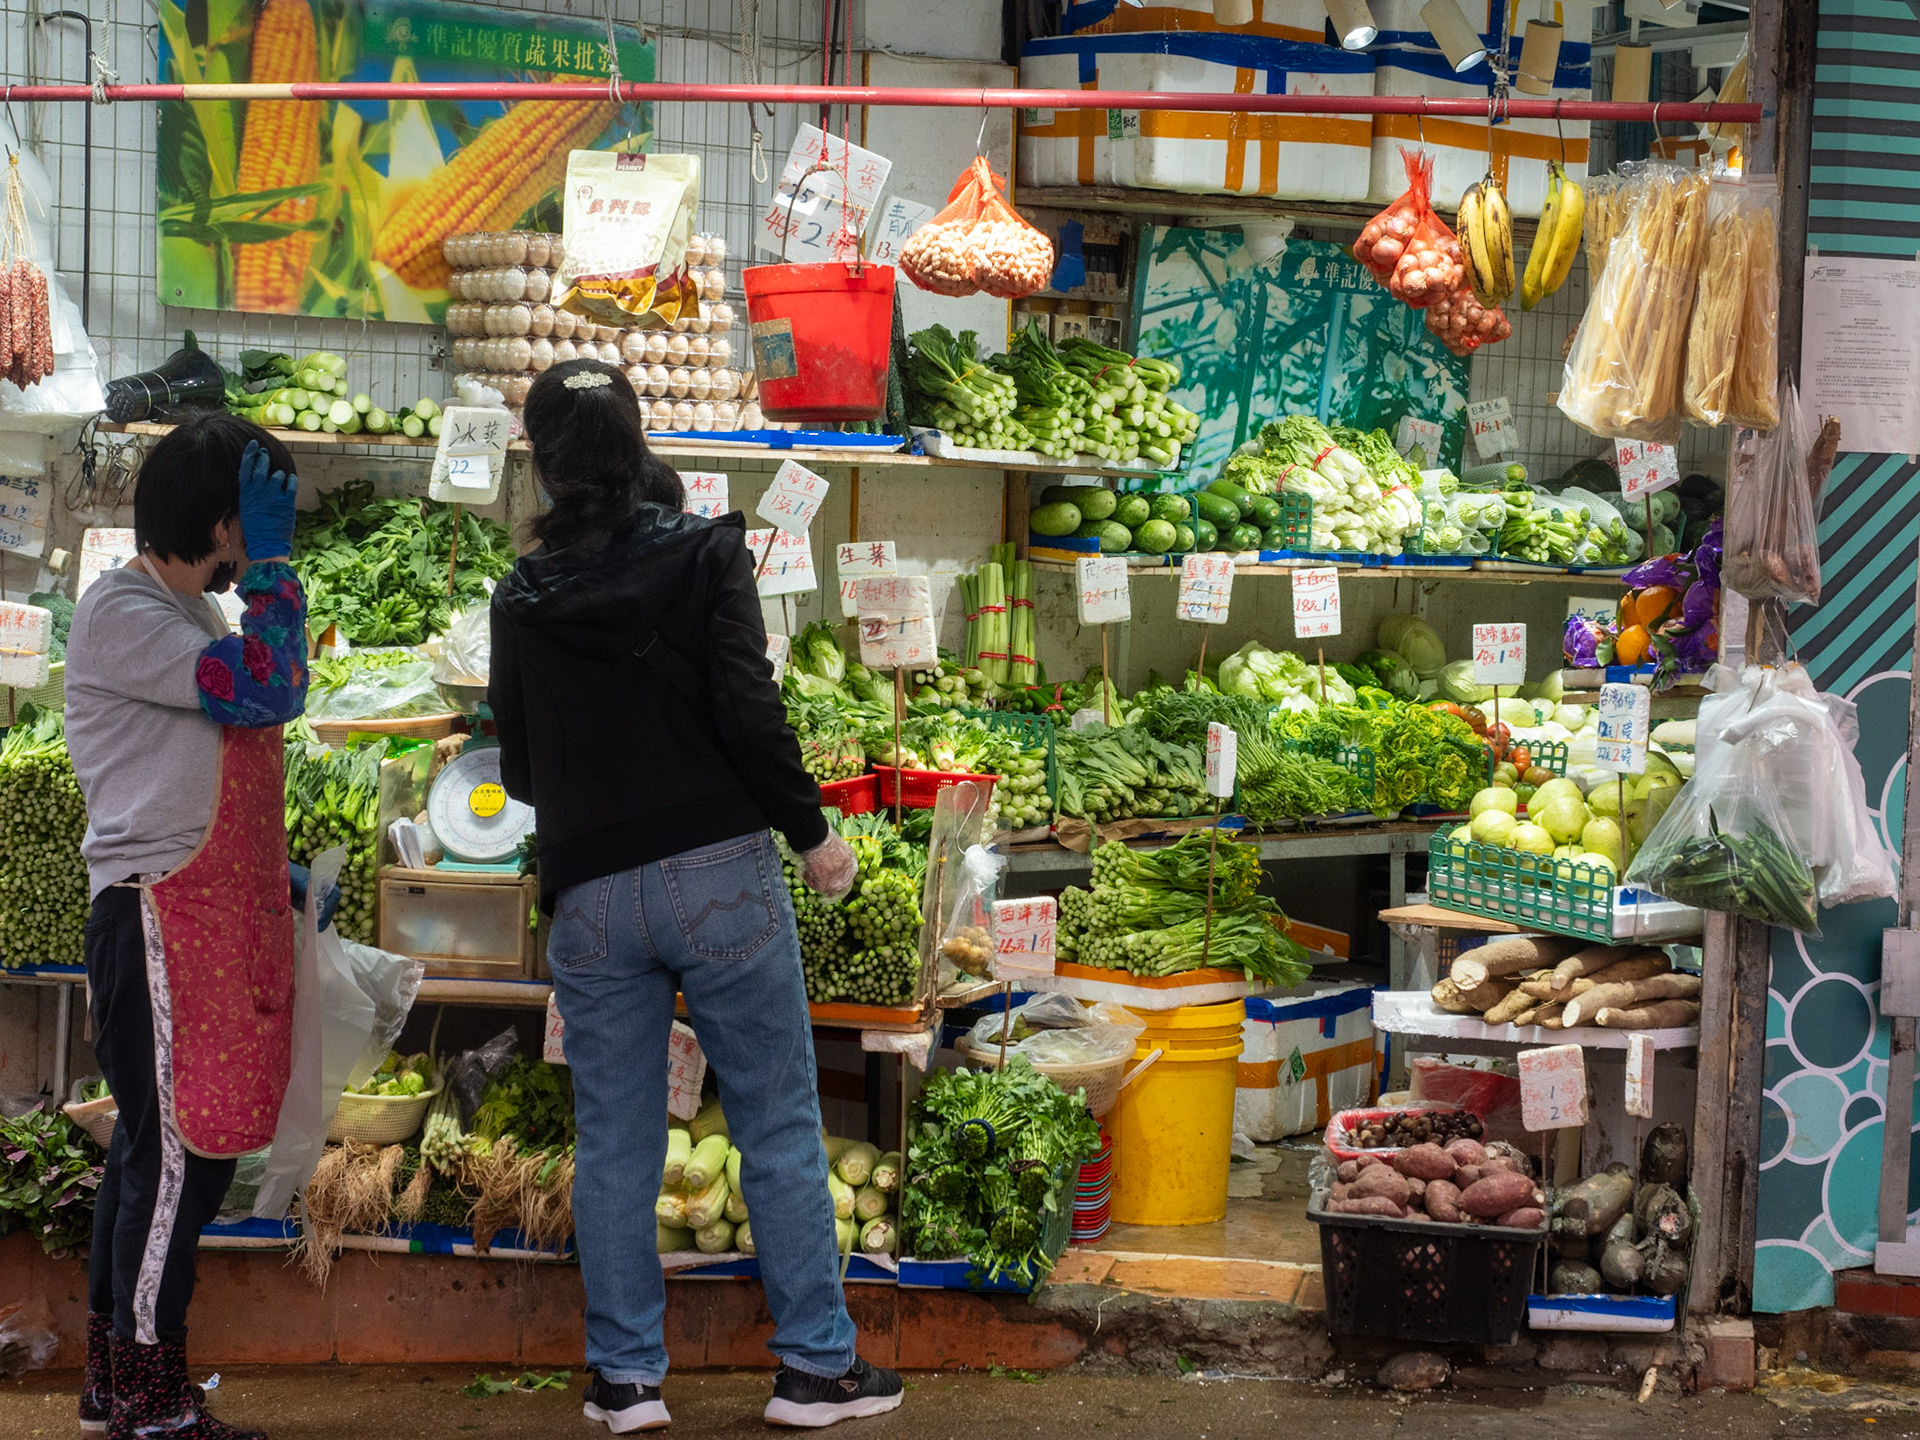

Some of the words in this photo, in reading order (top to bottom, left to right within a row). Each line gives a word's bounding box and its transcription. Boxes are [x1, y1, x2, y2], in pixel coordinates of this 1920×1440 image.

[1323, 262, 1389, 293] 準記優
[448, 420, 501, 450] 冰菜
[450, 459, 475, 474] 22
[840, 543, 891, 568] 生菜
[1184, 557, 1230, 580] 皇帝菜
[861, 579, 927, 602] 甜菜心
[1000, 902, 1054, 926] 西洋菜
